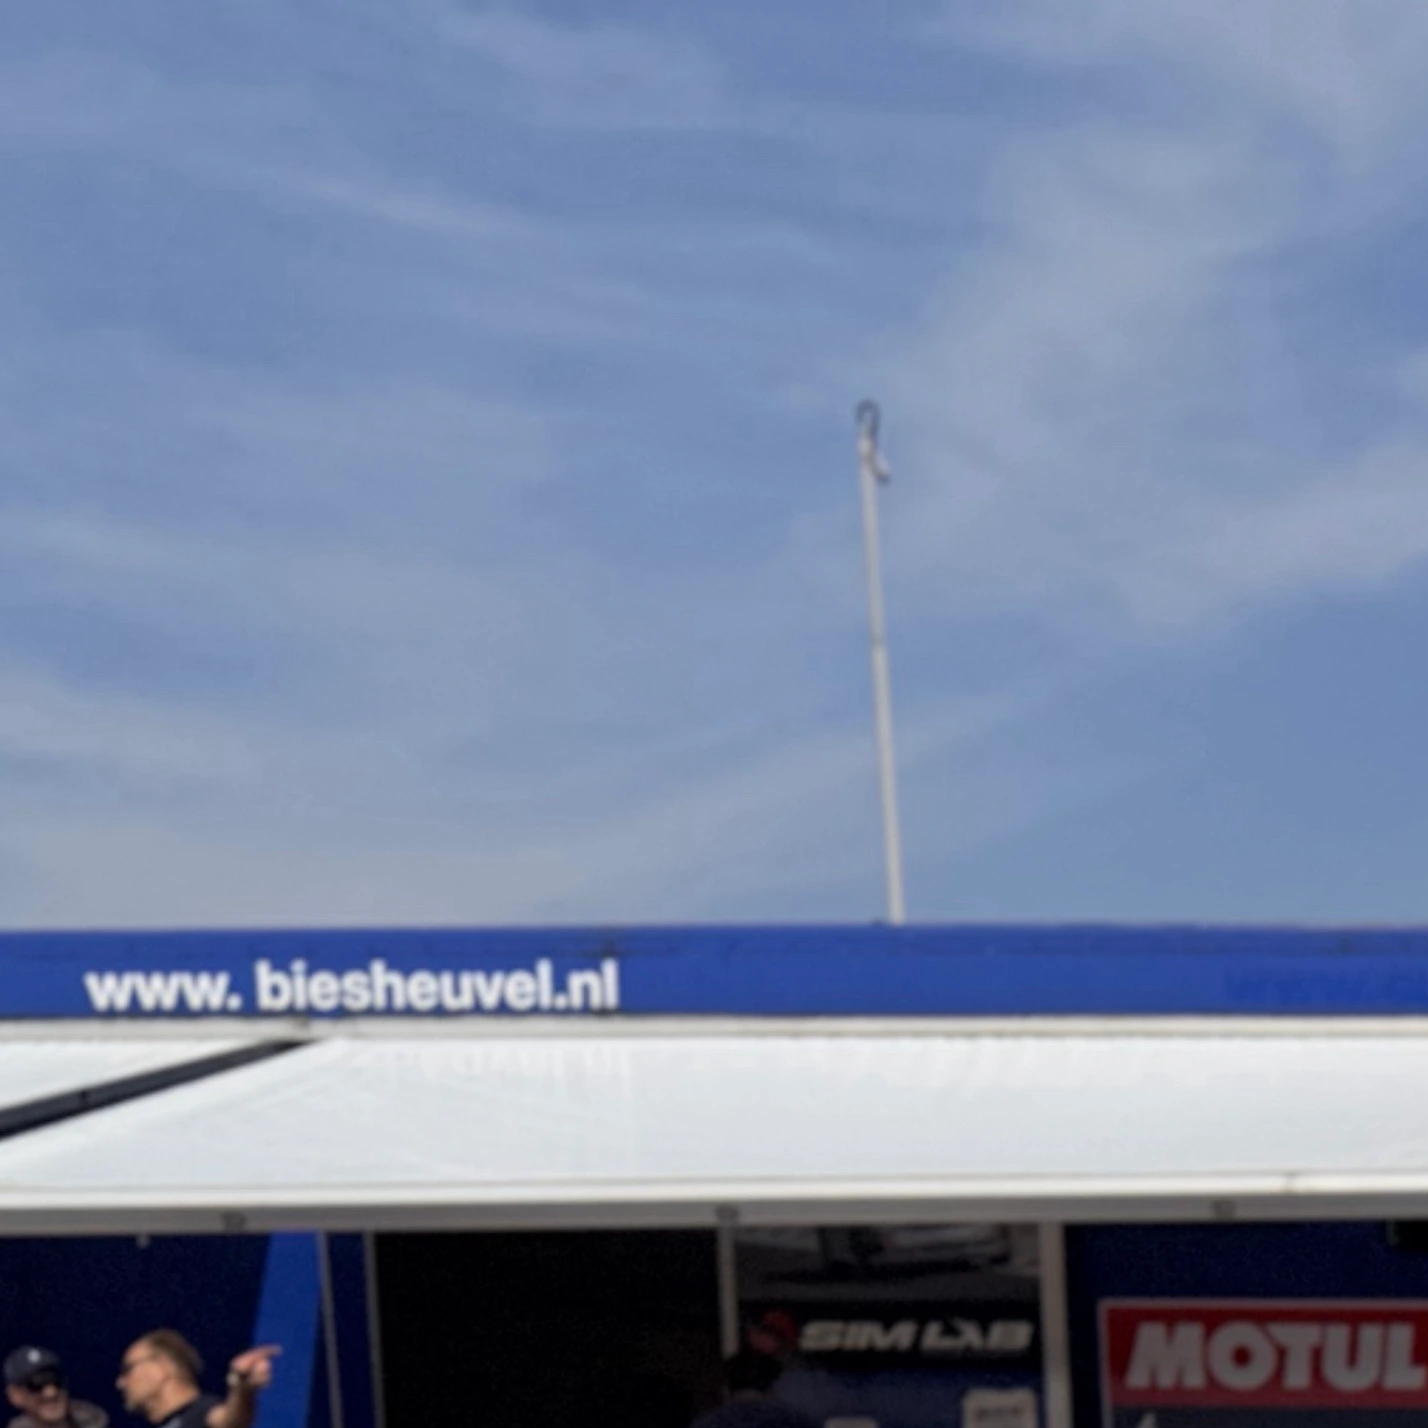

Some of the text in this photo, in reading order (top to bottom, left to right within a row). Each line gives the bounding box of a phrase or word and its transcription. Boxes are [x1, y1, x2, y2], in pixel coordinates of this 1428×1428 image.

[84, 958, 620, 1012] www. biesheuvel.nl
[1124, 1320, 1428, 1392] MOTUL
